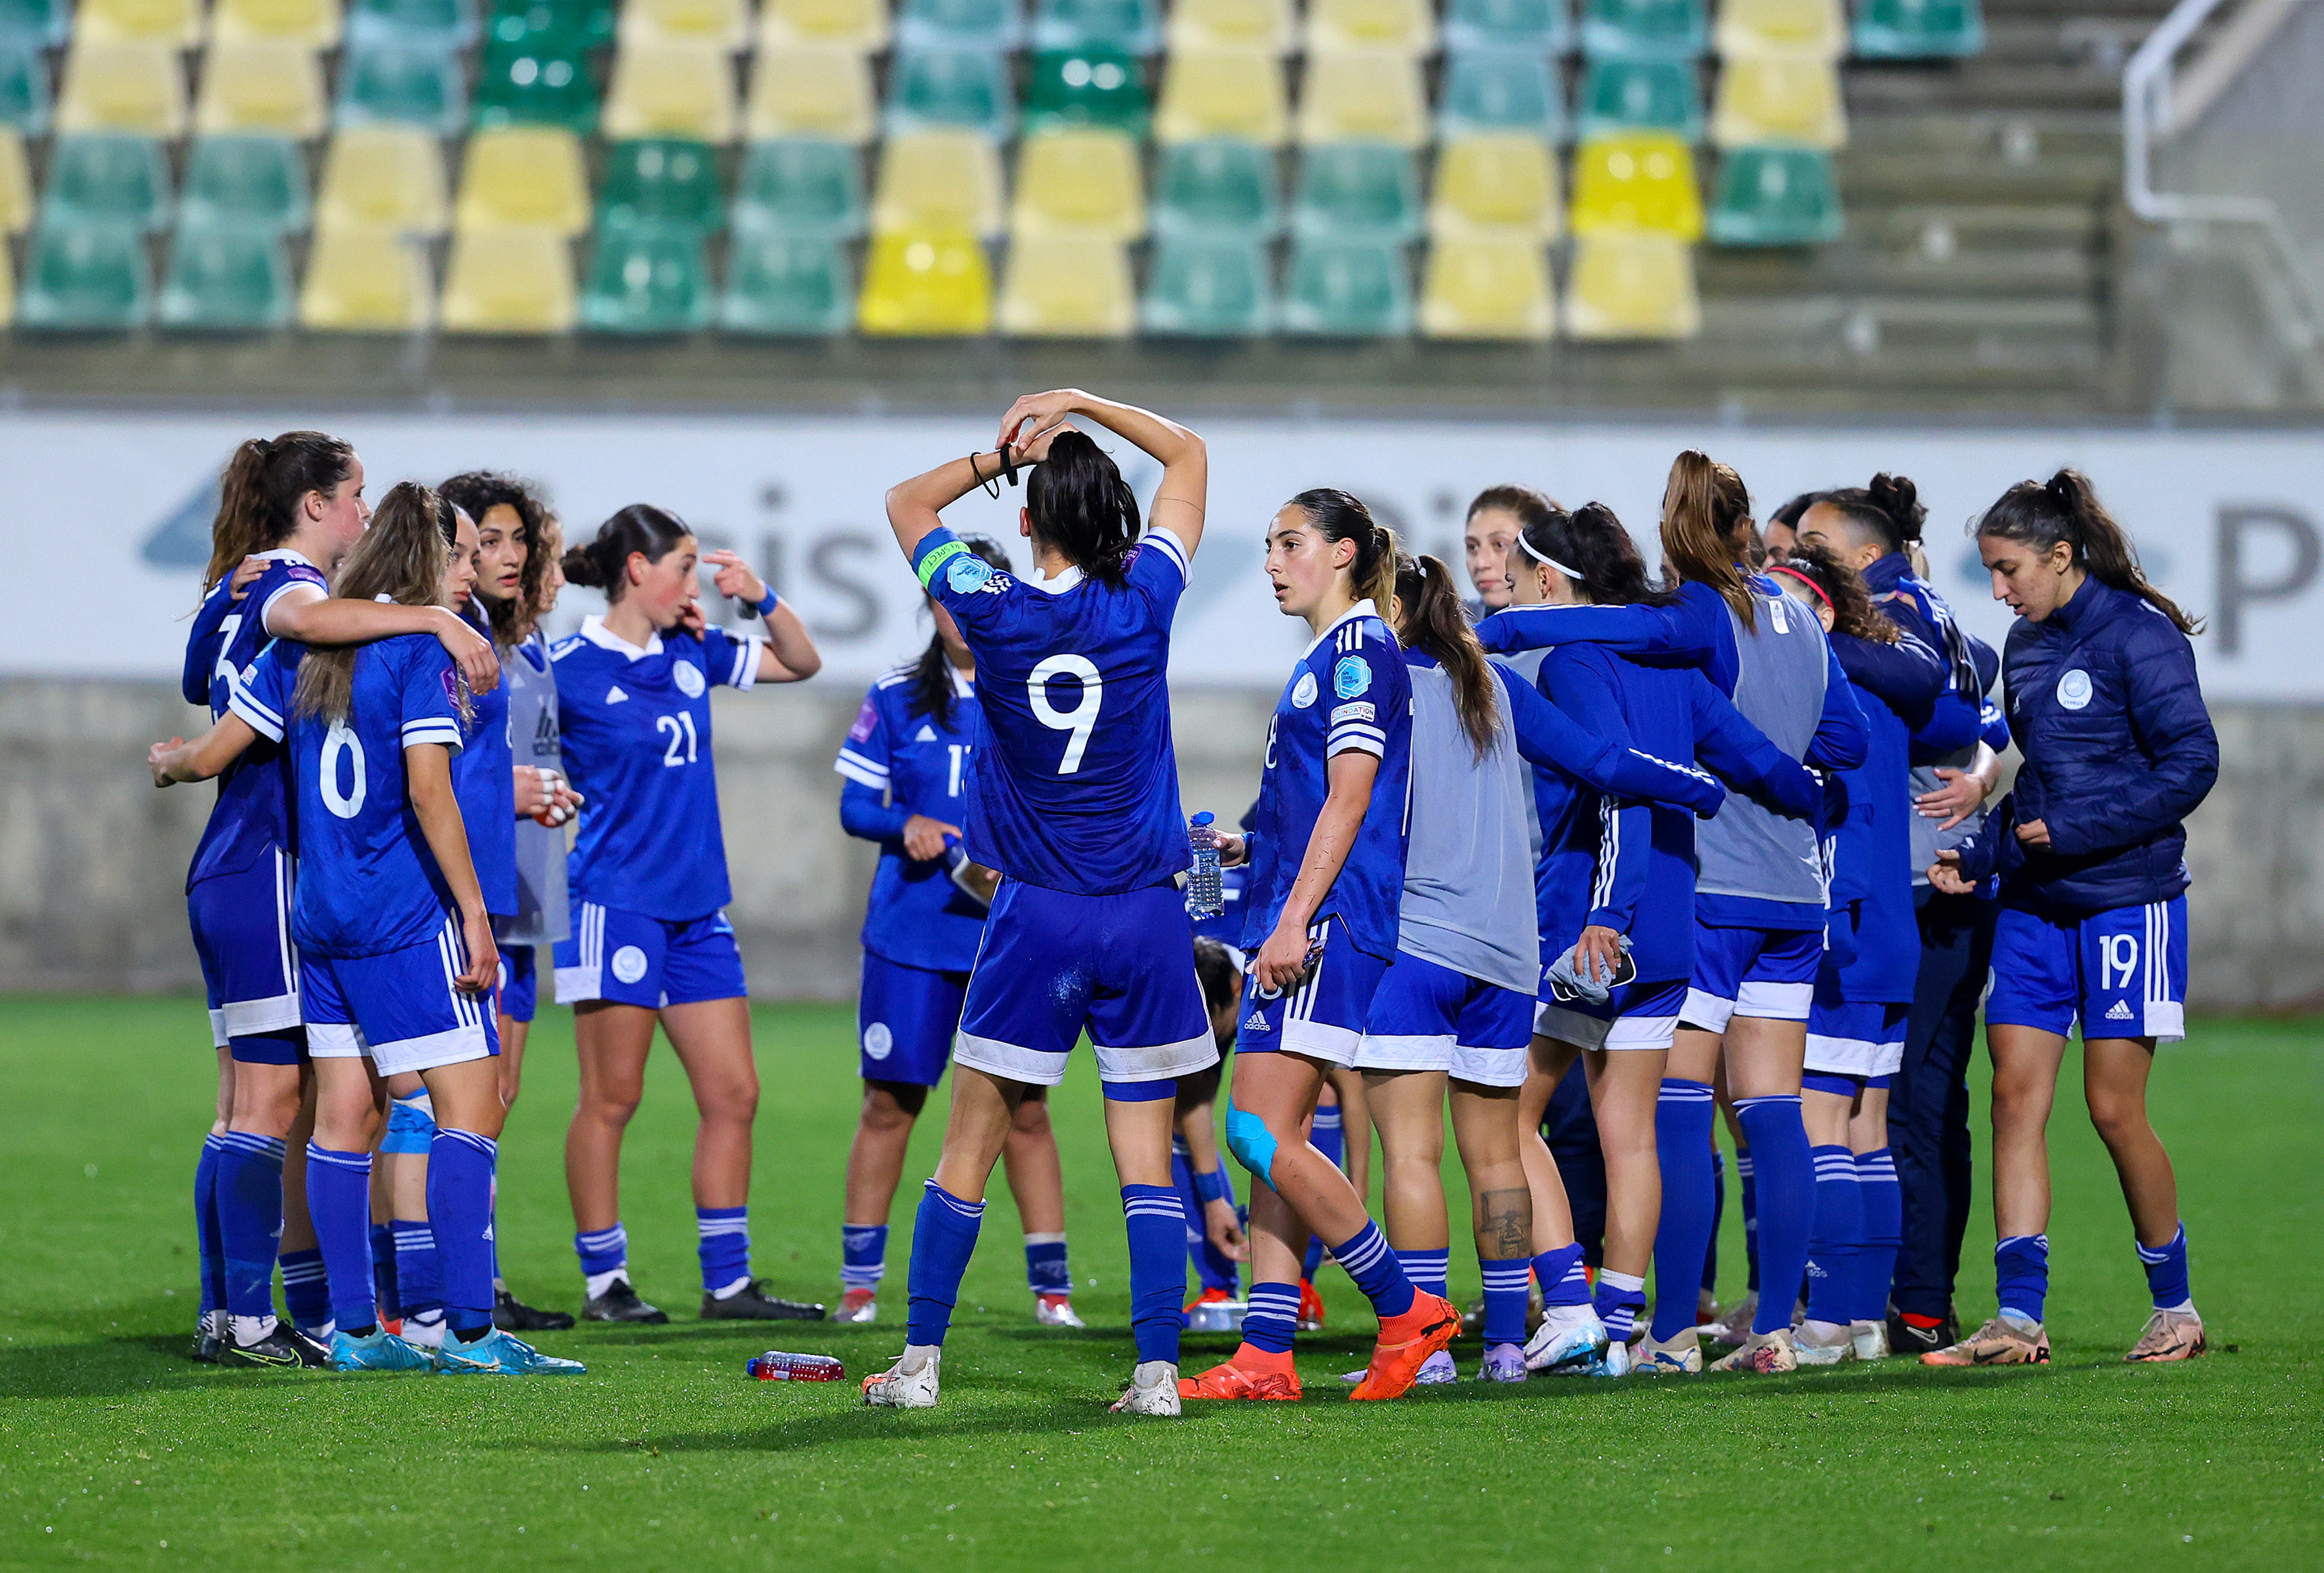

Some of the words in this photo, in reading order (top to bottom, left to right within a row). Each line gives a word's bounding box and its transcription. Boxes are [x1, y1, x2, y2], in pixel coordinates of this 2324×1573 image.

[928, 542, 960, 567] RESPECT
[1027, 653, 1103, 775] 9
[1332, 706, 1374, 719] FOUNDATION
[657, 710, 698, 767] 21
[2099, 933, 2138, 991] 19
[1244, 1022, 1271, 1031] adidas
